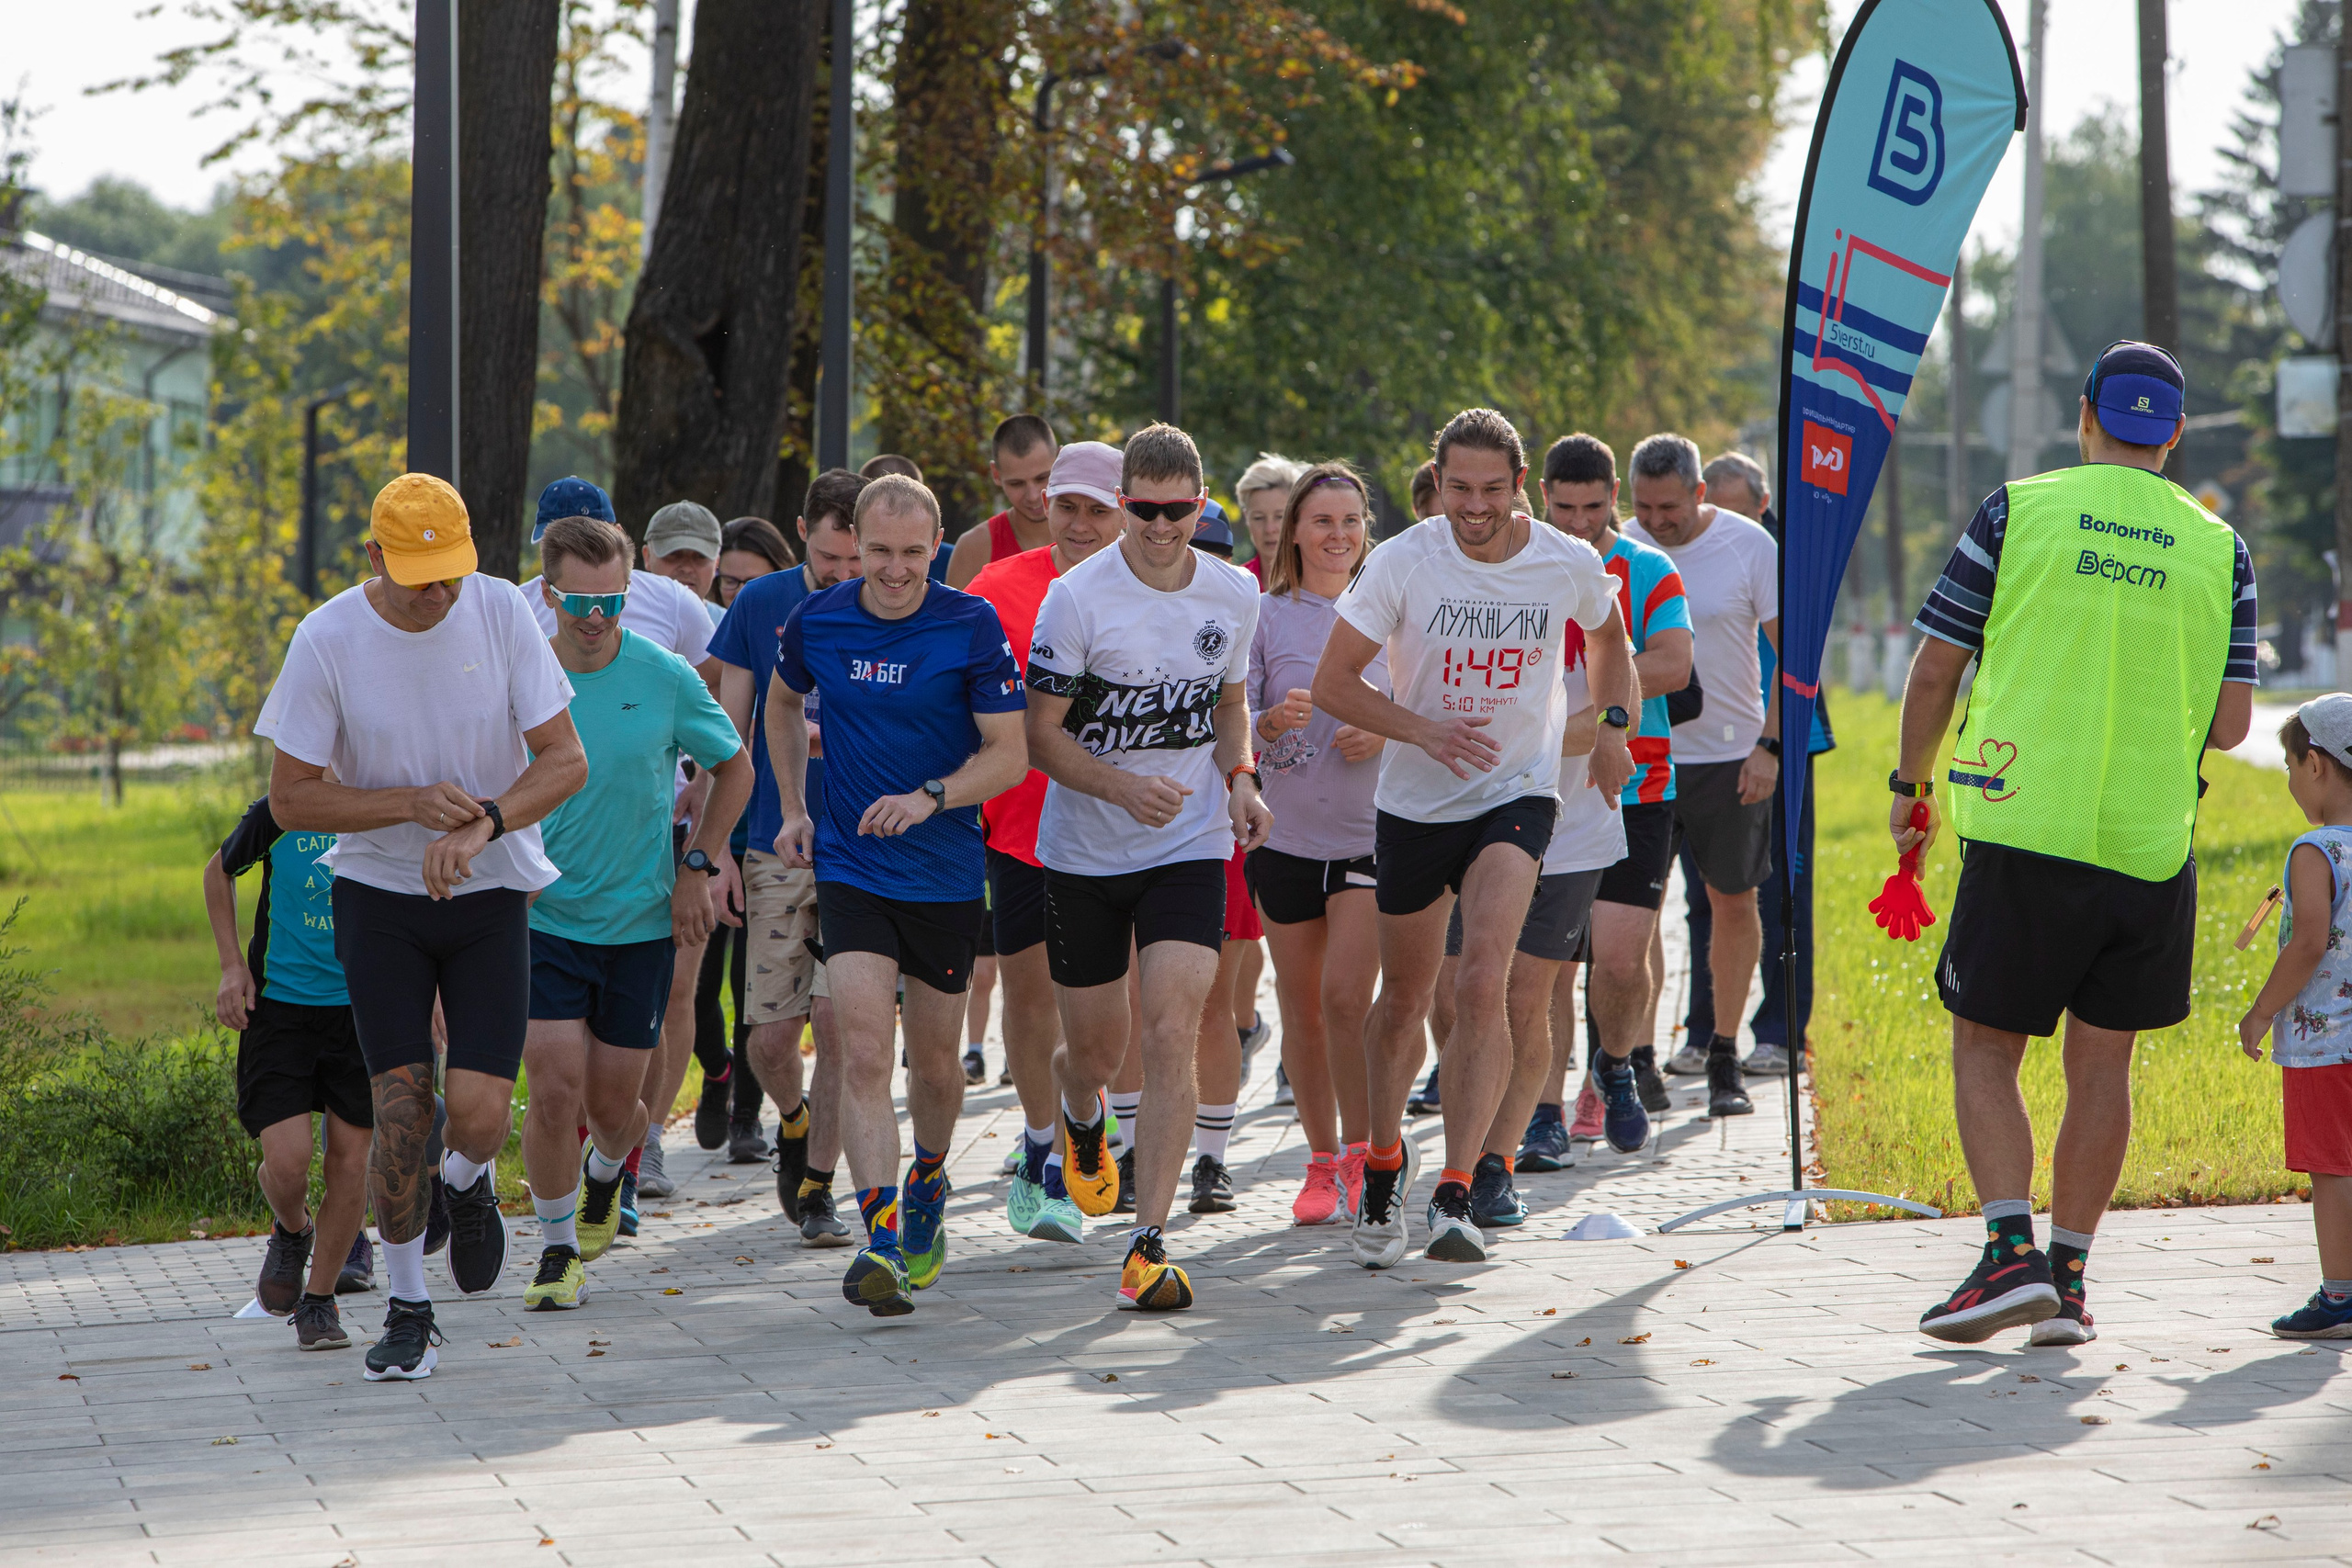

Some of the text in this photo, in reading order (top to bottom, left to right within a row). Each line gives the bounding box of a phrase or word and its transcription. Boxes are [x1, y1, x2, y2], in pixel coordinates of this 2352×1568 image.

[1830, 323, 1875, 358] 5verst.ru
[2079, 513, 2176, 549] Волонтёр
[1441, 597, 1508, 606] ПОЛУМАРАФОН
[1427, 604, 1549, 640] ЛУЖНИКИ
[1442, 648, 1524, 690] 1:49
[1442, 694, 1474, 713] 5:10
[305, 874, 315, 888] A
